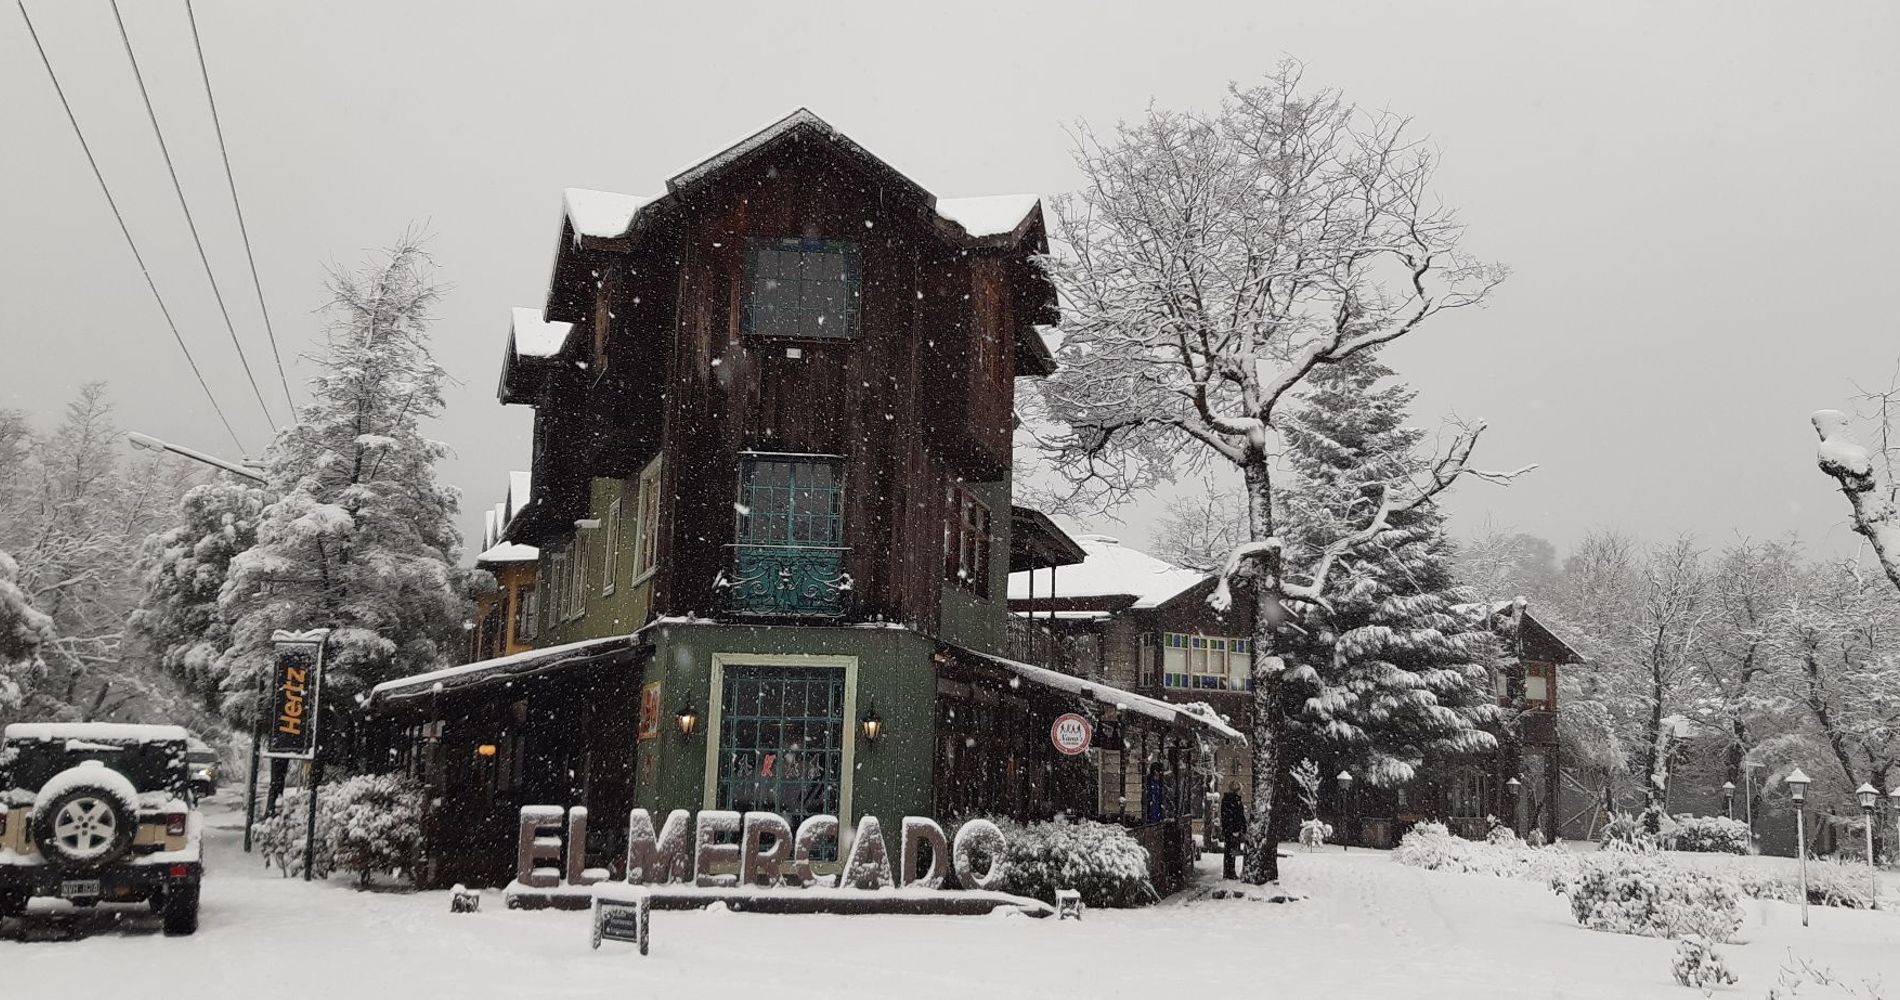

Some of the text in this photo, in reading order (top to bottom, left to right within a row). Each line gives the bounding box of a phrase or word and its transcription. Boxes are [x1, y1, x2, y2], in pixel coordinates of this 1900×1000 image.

[279, 667, 306, 735] Hertz
[517, 805, 1007, 890] EL MERCADO
